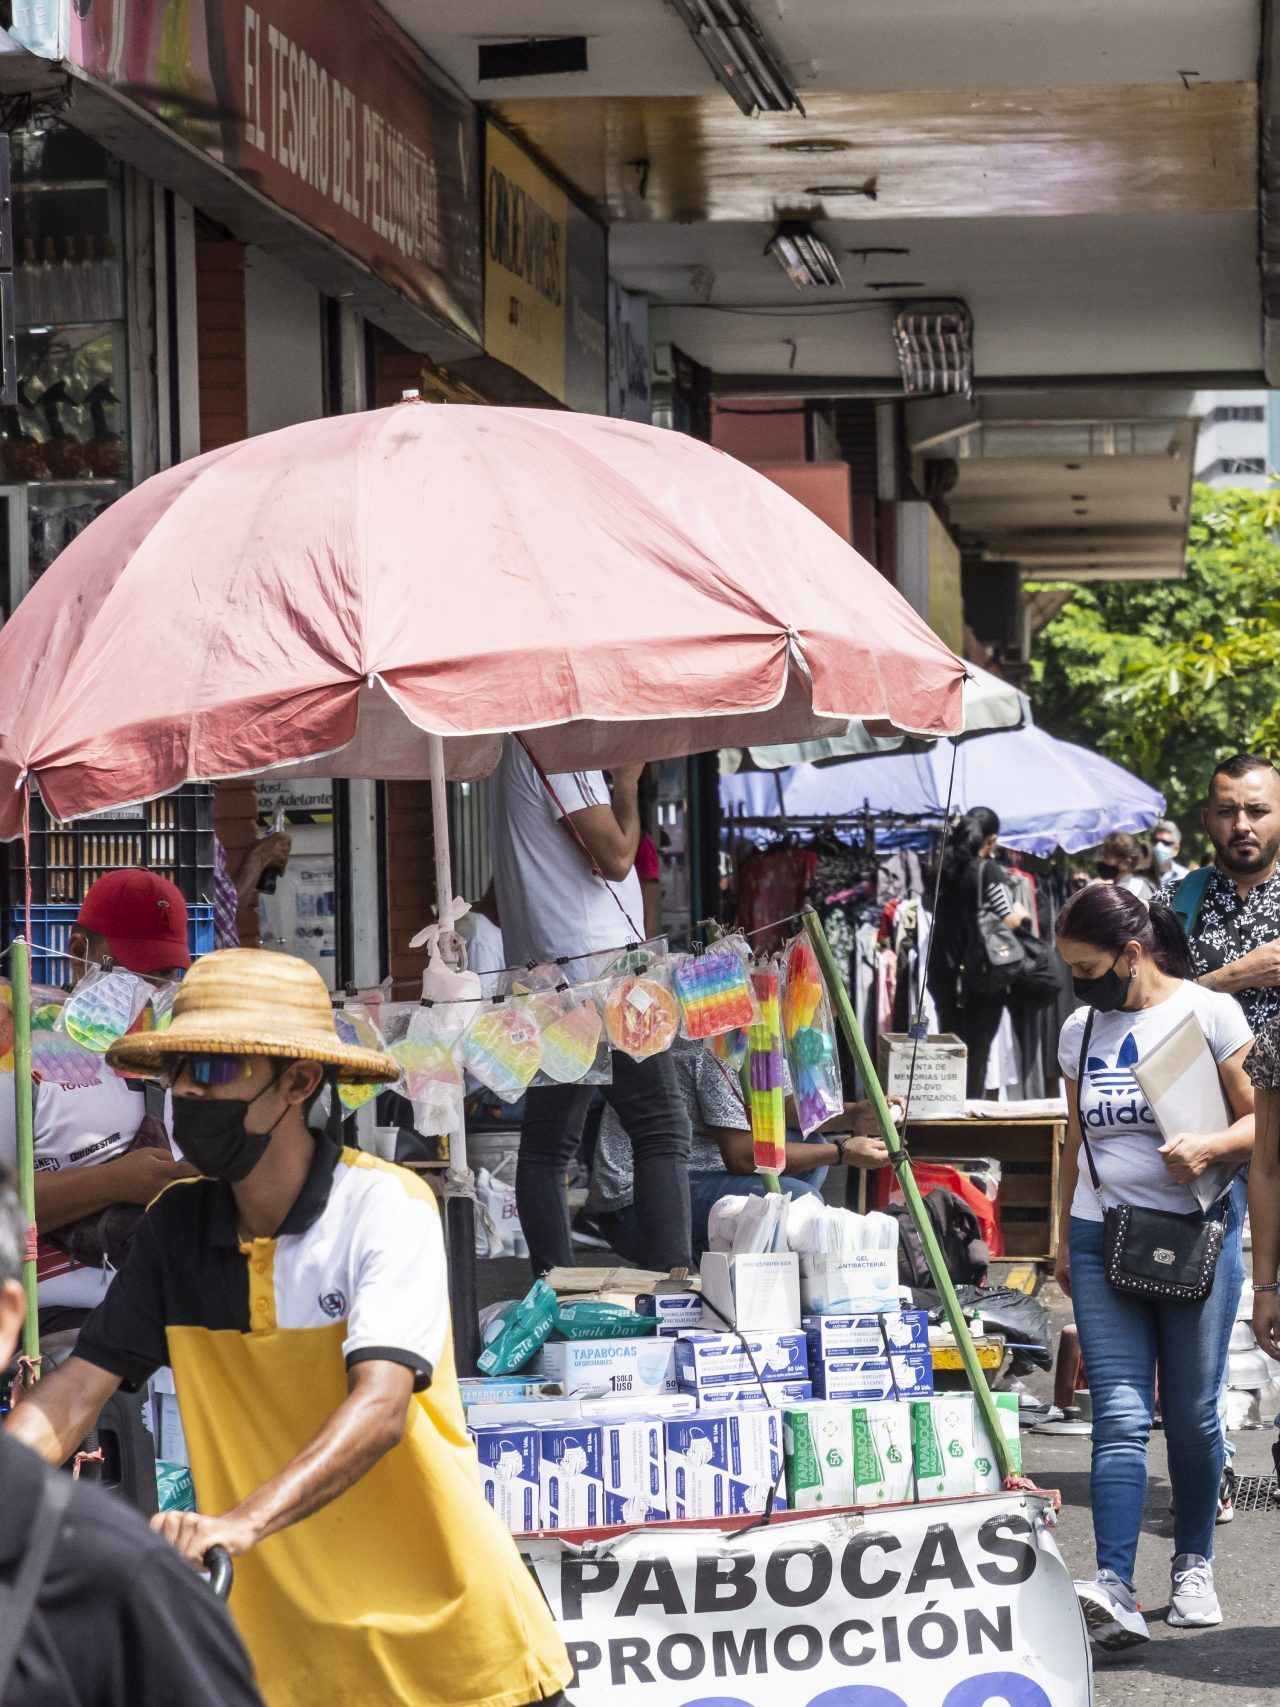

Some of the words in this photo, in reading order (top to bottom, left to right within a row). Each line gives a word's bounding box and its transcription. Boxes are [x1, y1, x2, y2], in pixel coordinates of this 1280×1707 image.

[245, 5, 266, 153] EL
[268, 23, 329, 198] TESORO
[333, 77, 360, 220] DEL
[837, 1261, 888, 1269] ANTIBACTERIAL
[570, 1325, 607, 1337] Smile
[611, 1324, 638, 1336] Day
[507, 1338, 534, 1369] Smile
[573, 1346, 638, 1360] TAPABOCAS
[574, 1359, 613, 1367] DESECHABLES
[609, 1375, 616, 1391] 1
[616, 1374, 633, 1382] SOLO
[665, 1380, 676, 1388] 50
[616, 1382, 633, 1391] USO
[856, 1411, 868, 1482] TAPABOCAS
[919, 1405, 931, 1475] TAPABOCAS
[797, 1415, 808, 1485] TAPABOCAS
[890, 1446, 901, 1461] 50
[951, 1441, 961, 1456] 50
[830, 1451, 840, 1465] 50
[977, 1459, 987, 1474] 50
[520, 1513, 1038, 1622] PABOCAS
[565, 1600, 1014, 1689] PROMOCIÓN
